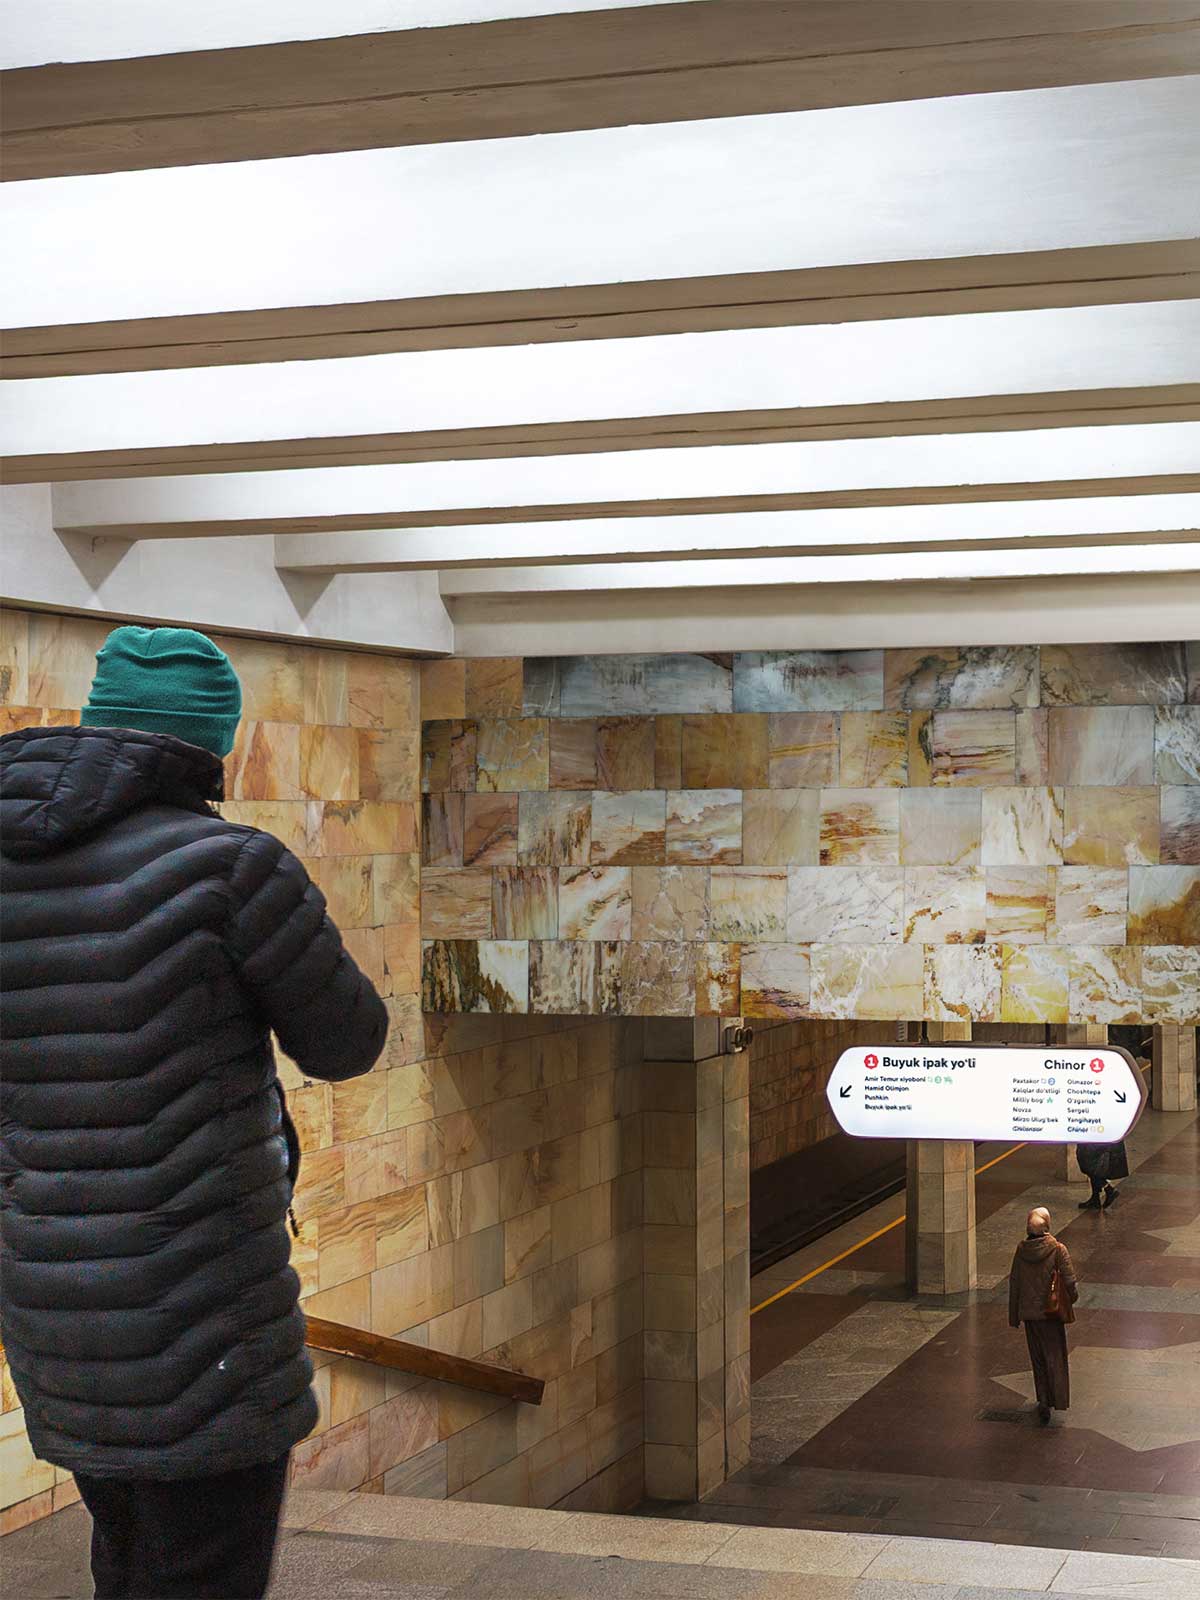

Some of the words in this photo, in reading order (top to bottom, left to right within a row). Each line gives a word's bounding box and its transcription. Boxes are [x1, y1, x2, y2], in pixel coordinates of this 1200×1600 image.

[867, 1057, 876, 1066] 1
[882, 1057, 920, 1069] Buyuk
[923, 1057, 949, 1069] ipak
[1044, 1059, 1086, 1070] Chinor
[1092, 1061, 1101, 1070] 1
[900, 1076, 926, 1084] xiyoboni
[1067, 1088, 1101, 1096] Choshtepa
